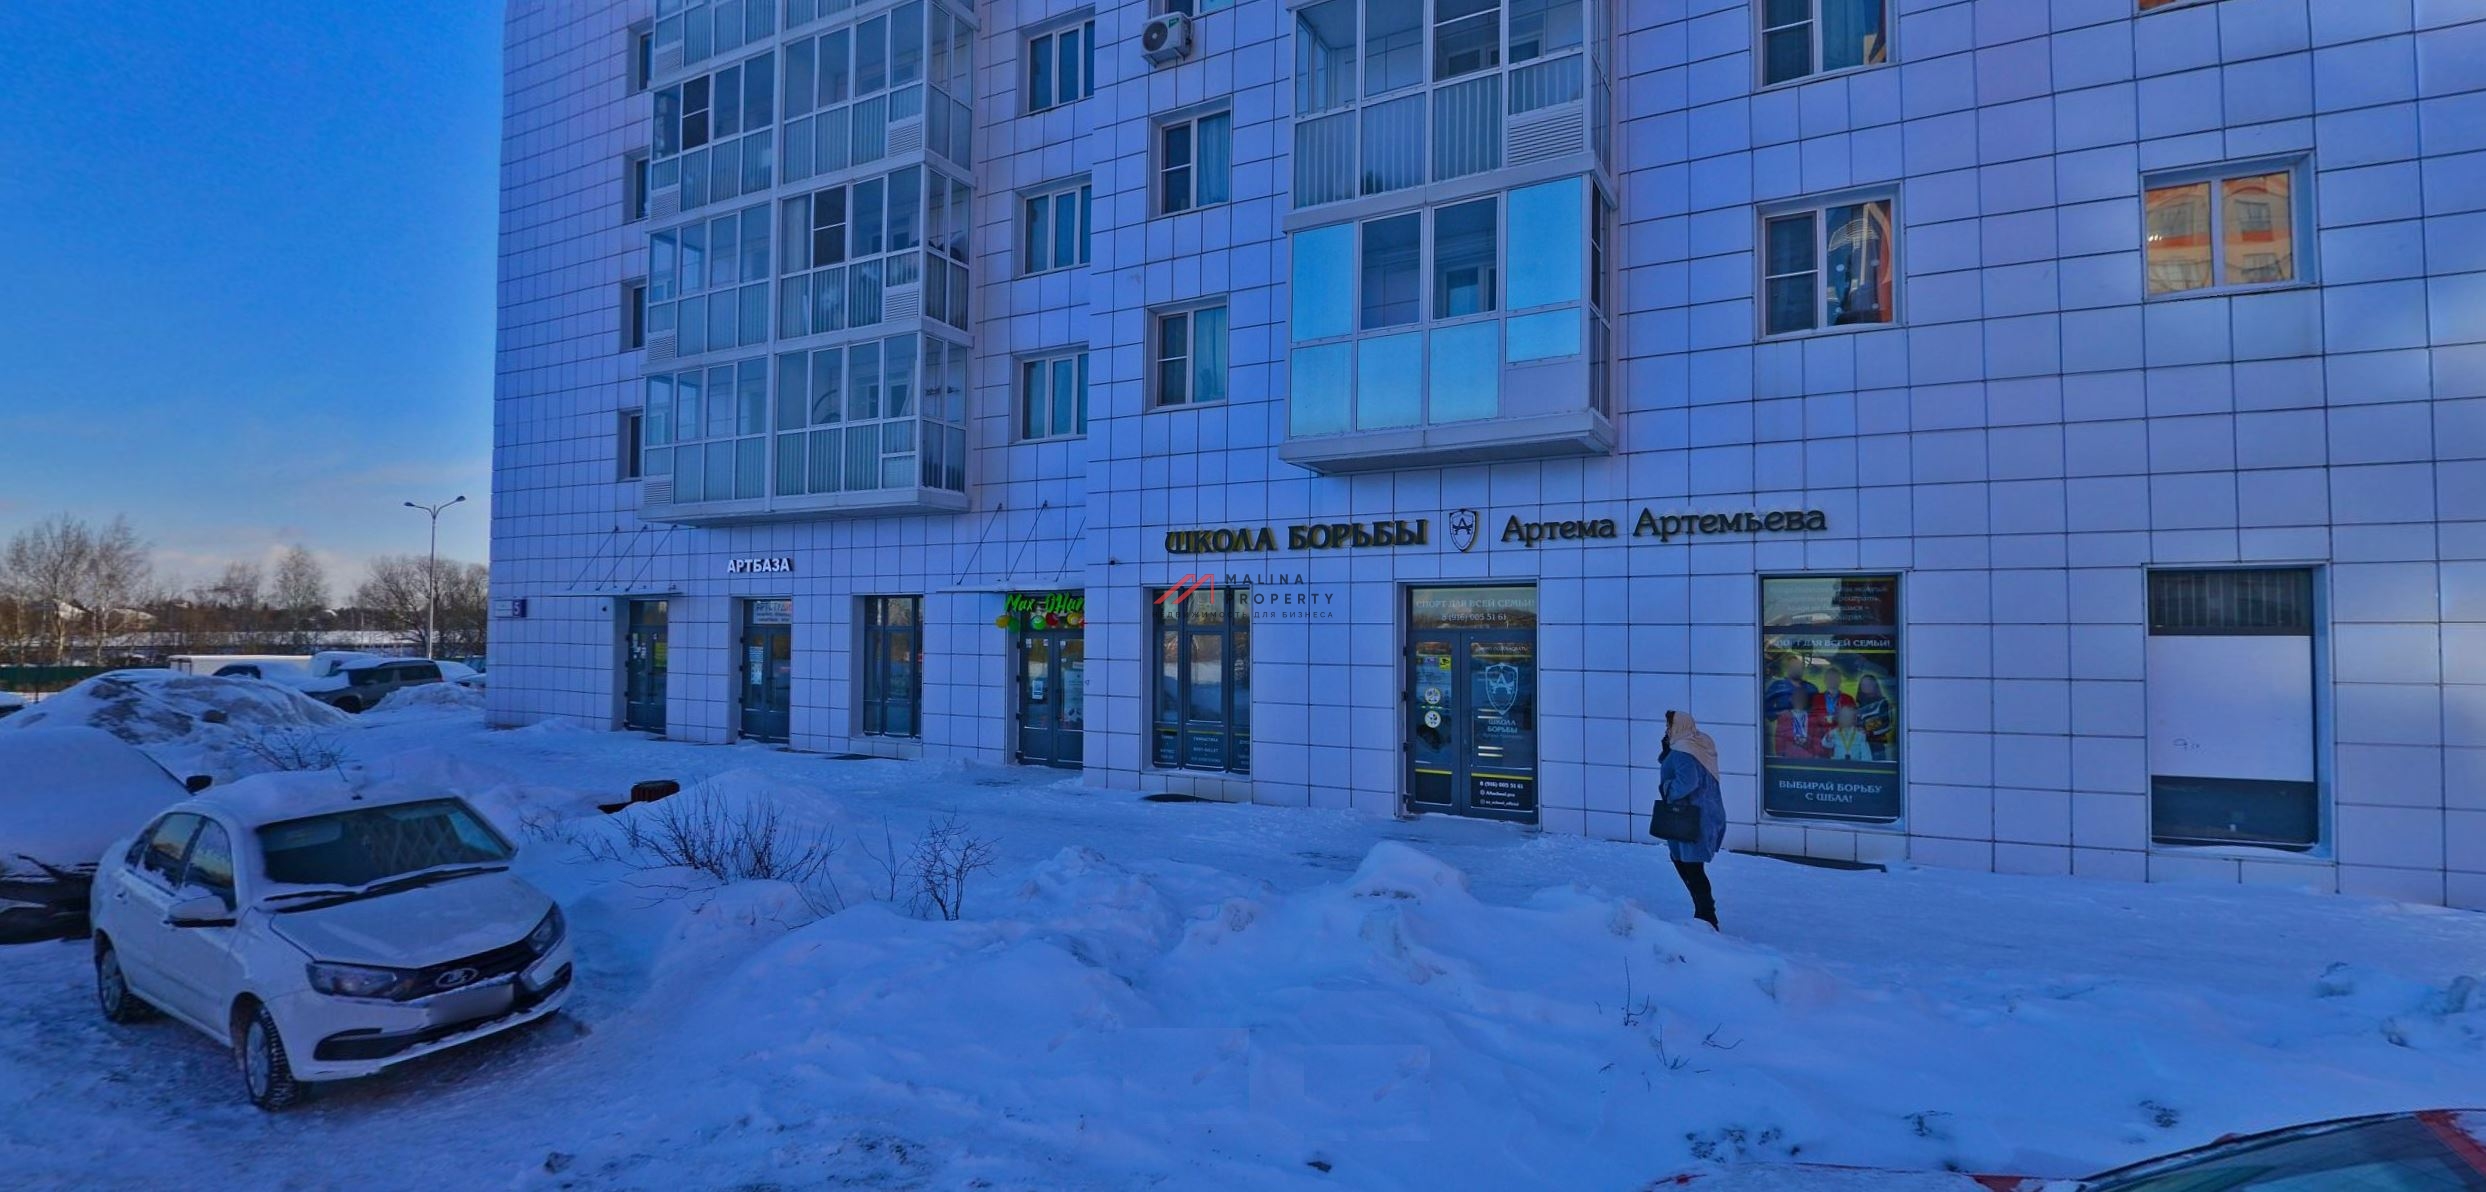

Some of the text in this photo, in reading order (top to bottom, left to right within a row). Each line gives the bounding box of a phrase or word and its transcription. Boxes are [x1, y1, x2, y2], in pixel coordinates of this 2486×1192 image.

[1501, 507, 1827, 548] Артема Артемьева
[1164, 518, 1430, 554] ШКОЛА БОРЬБЫ
[727, 558, 791, 573] АРТБАЗА
[512, 602, 521, 616] 5
[1487, 725, 1518, 734] БОРЬБЫ
[1488, 719, 1517, 727] ШКОЛА
[1779, 780, 1883, 794] ВЫБИРАЙ БОРЬБУ
[1804, 792, 1814, 801] С
